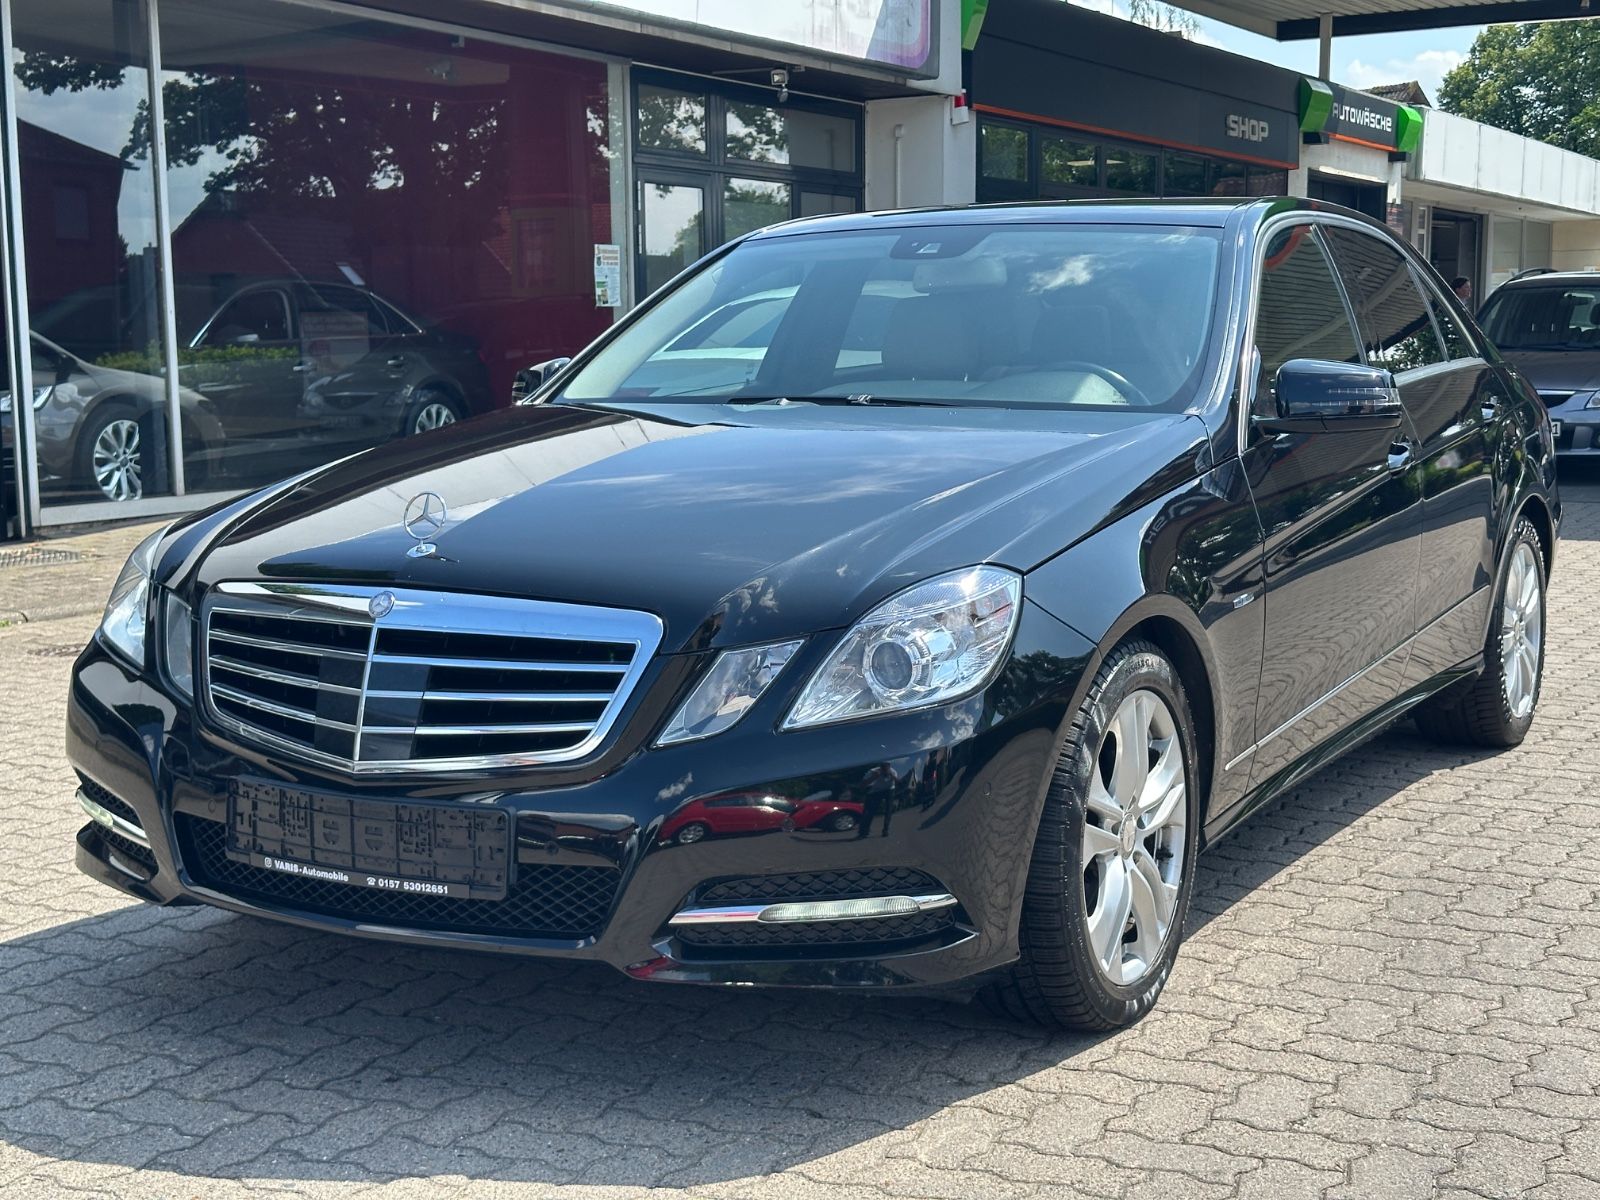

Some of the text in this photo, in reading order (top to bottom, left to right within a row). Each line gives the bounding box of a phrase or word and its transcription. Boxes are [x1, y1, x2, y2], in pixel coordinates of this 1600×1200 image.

[1226, 114, 1269, 142] SHOP
[378, 878, 400, 889] 0157
[403, 881, 449, 895] 53012651
